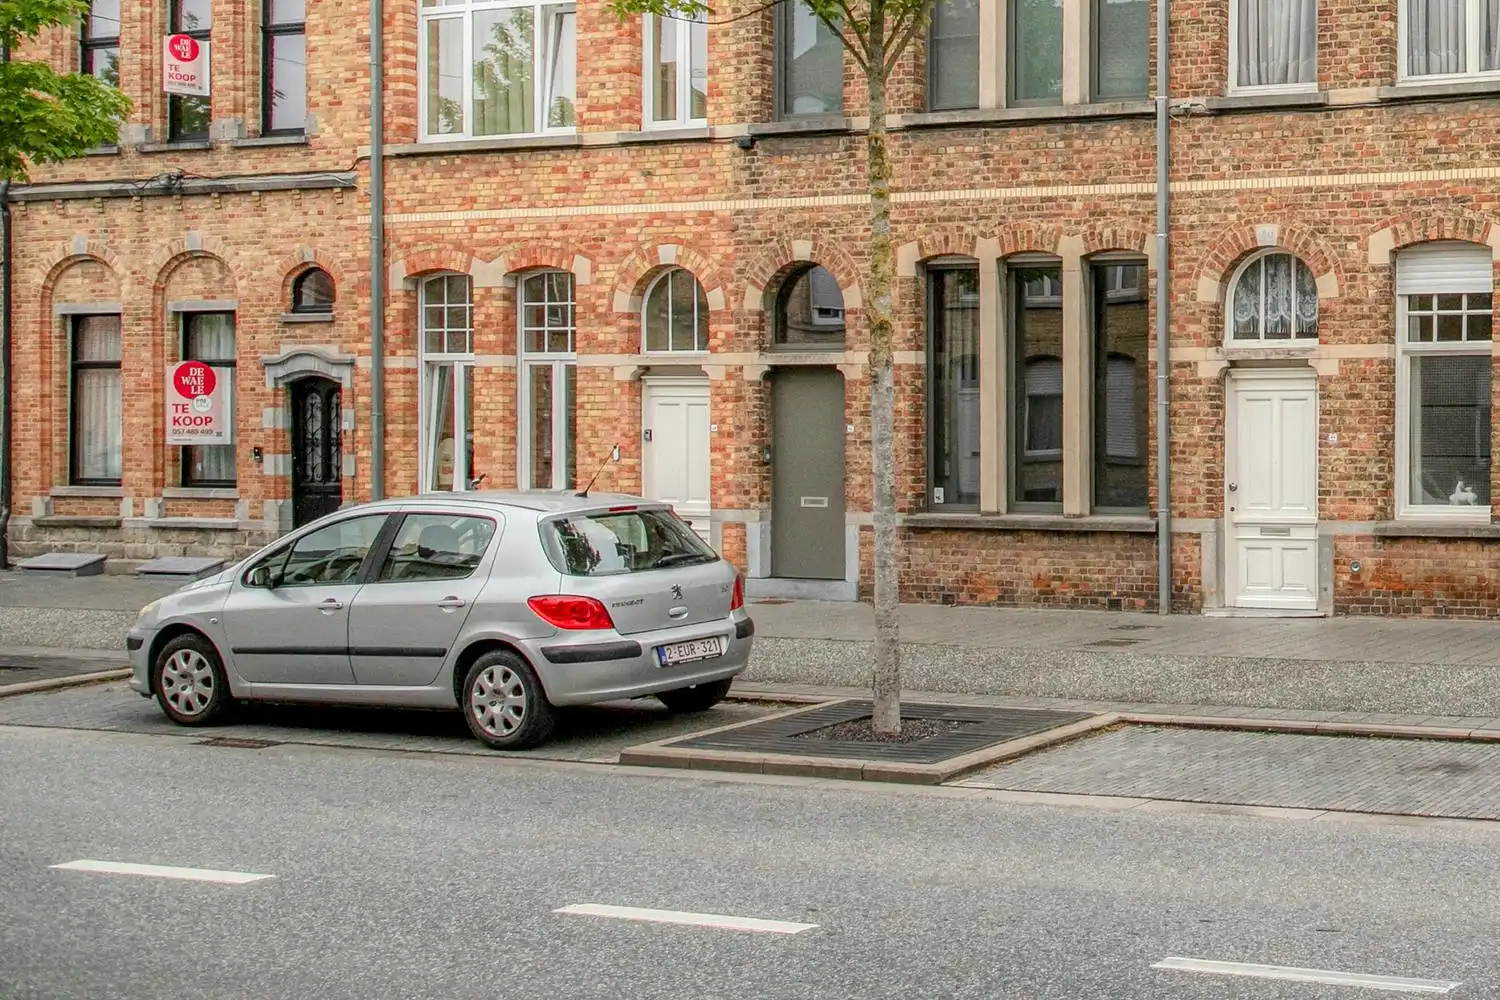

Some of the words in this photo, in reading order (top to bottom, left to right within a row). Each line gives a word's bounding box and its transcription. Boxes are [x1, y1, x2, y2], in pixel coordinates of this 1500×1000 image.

[168, 64, 180, 72] TE
[168, 72, 196, 81] KOOP
[189, 367, 204, 377] DE
[181, 376, 204, 386] WAE
[191, 385, 204, 395] LE
[172, 403, 189, 414] TE
[172, 416, 213, 427] KOOP
[666, 640, 719, 660] 2-EUR-321
